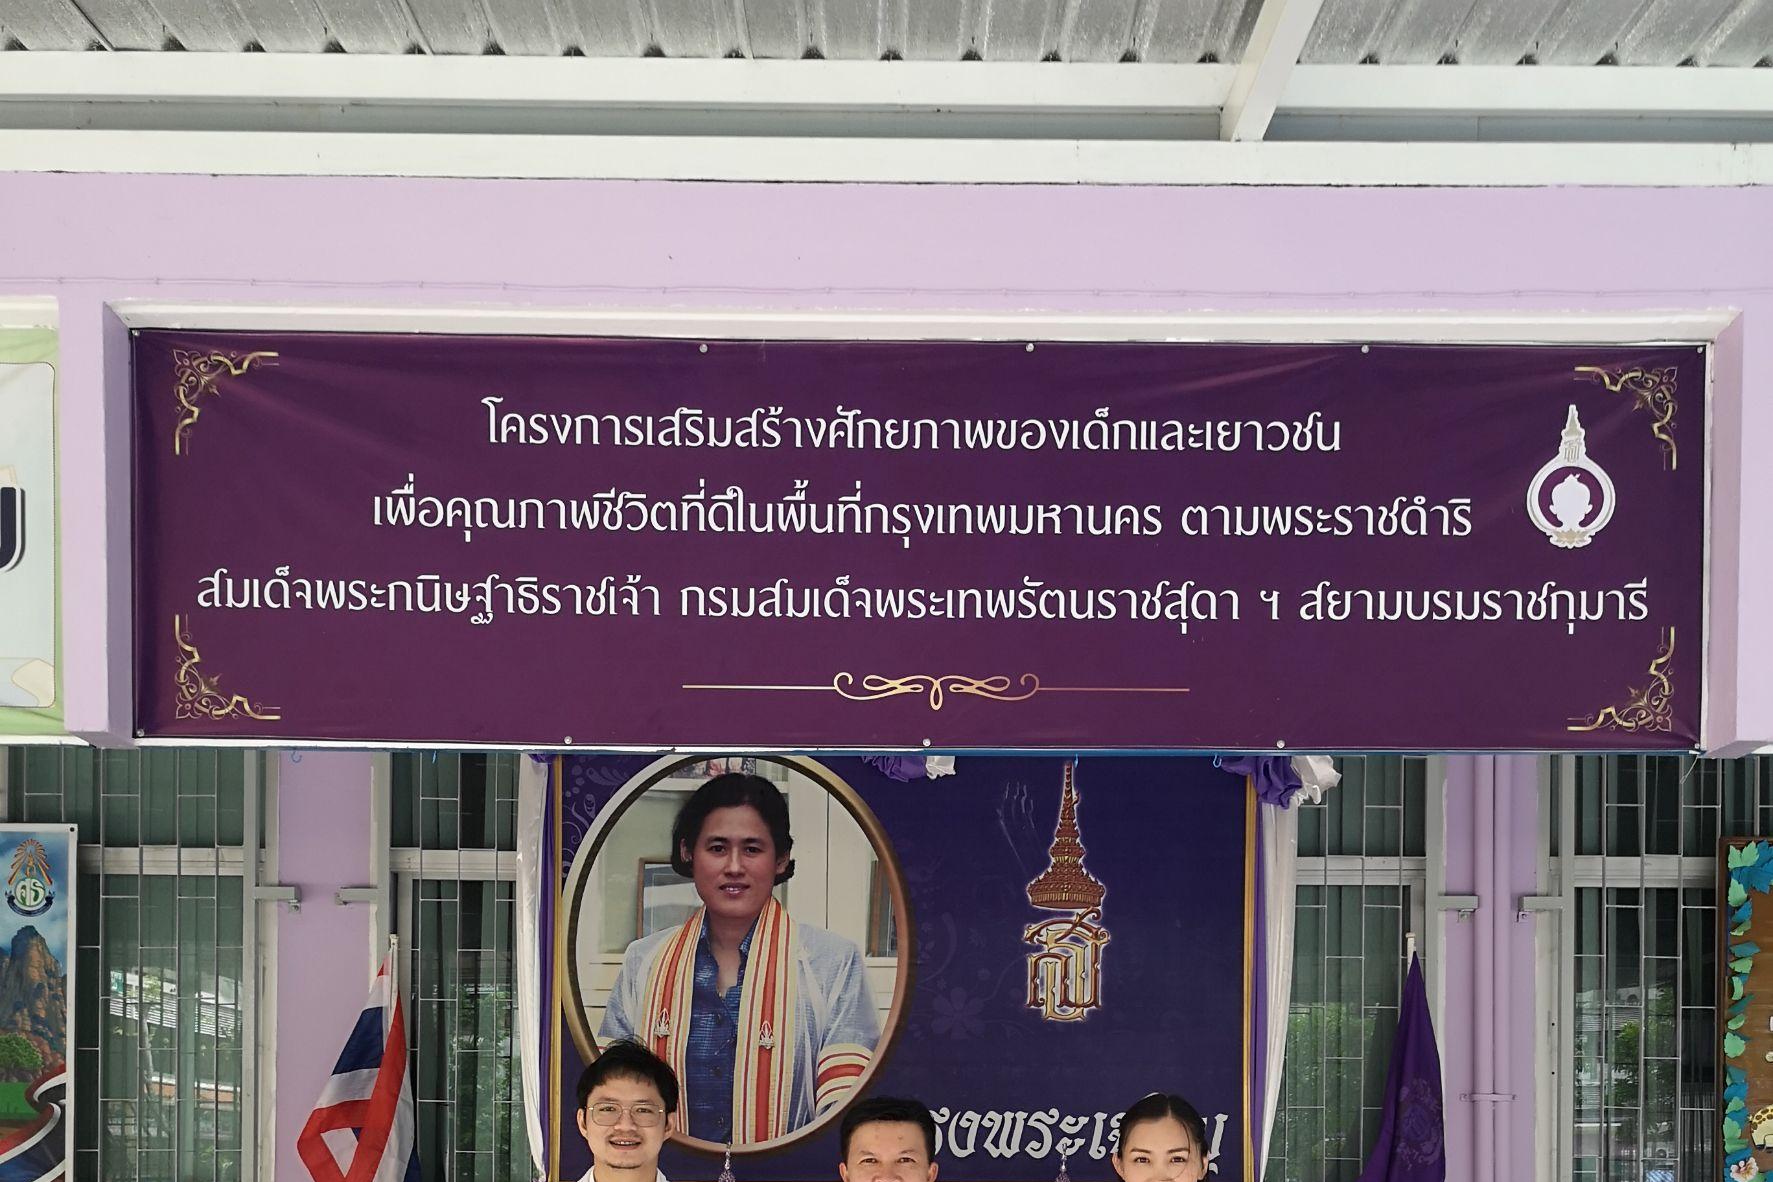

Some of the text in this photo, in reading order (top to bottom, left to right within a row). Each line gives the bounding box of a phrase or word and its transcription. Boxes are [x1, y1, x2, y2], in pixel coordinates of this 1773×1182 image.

[481, 396, 1342, 452] โครงการเสริมสร้างศักยภาพของเด็กและเยาวชน
[373, 473, 1472, 548] เพื่อคุณภาพชีวิตที่ดีในพื้นที่กรุงเทพมหานคร ตามพระราชดำริ
[197, 566, 661, 624] สมเด็จพระกนิษฐาธิราชเจ้า
[680, 574, 1240, 635] กรมสมเด็จพระเทพรัตนราชสุดา
[1299, 576, 1650, 635] สยามบรมราชกุมารี
